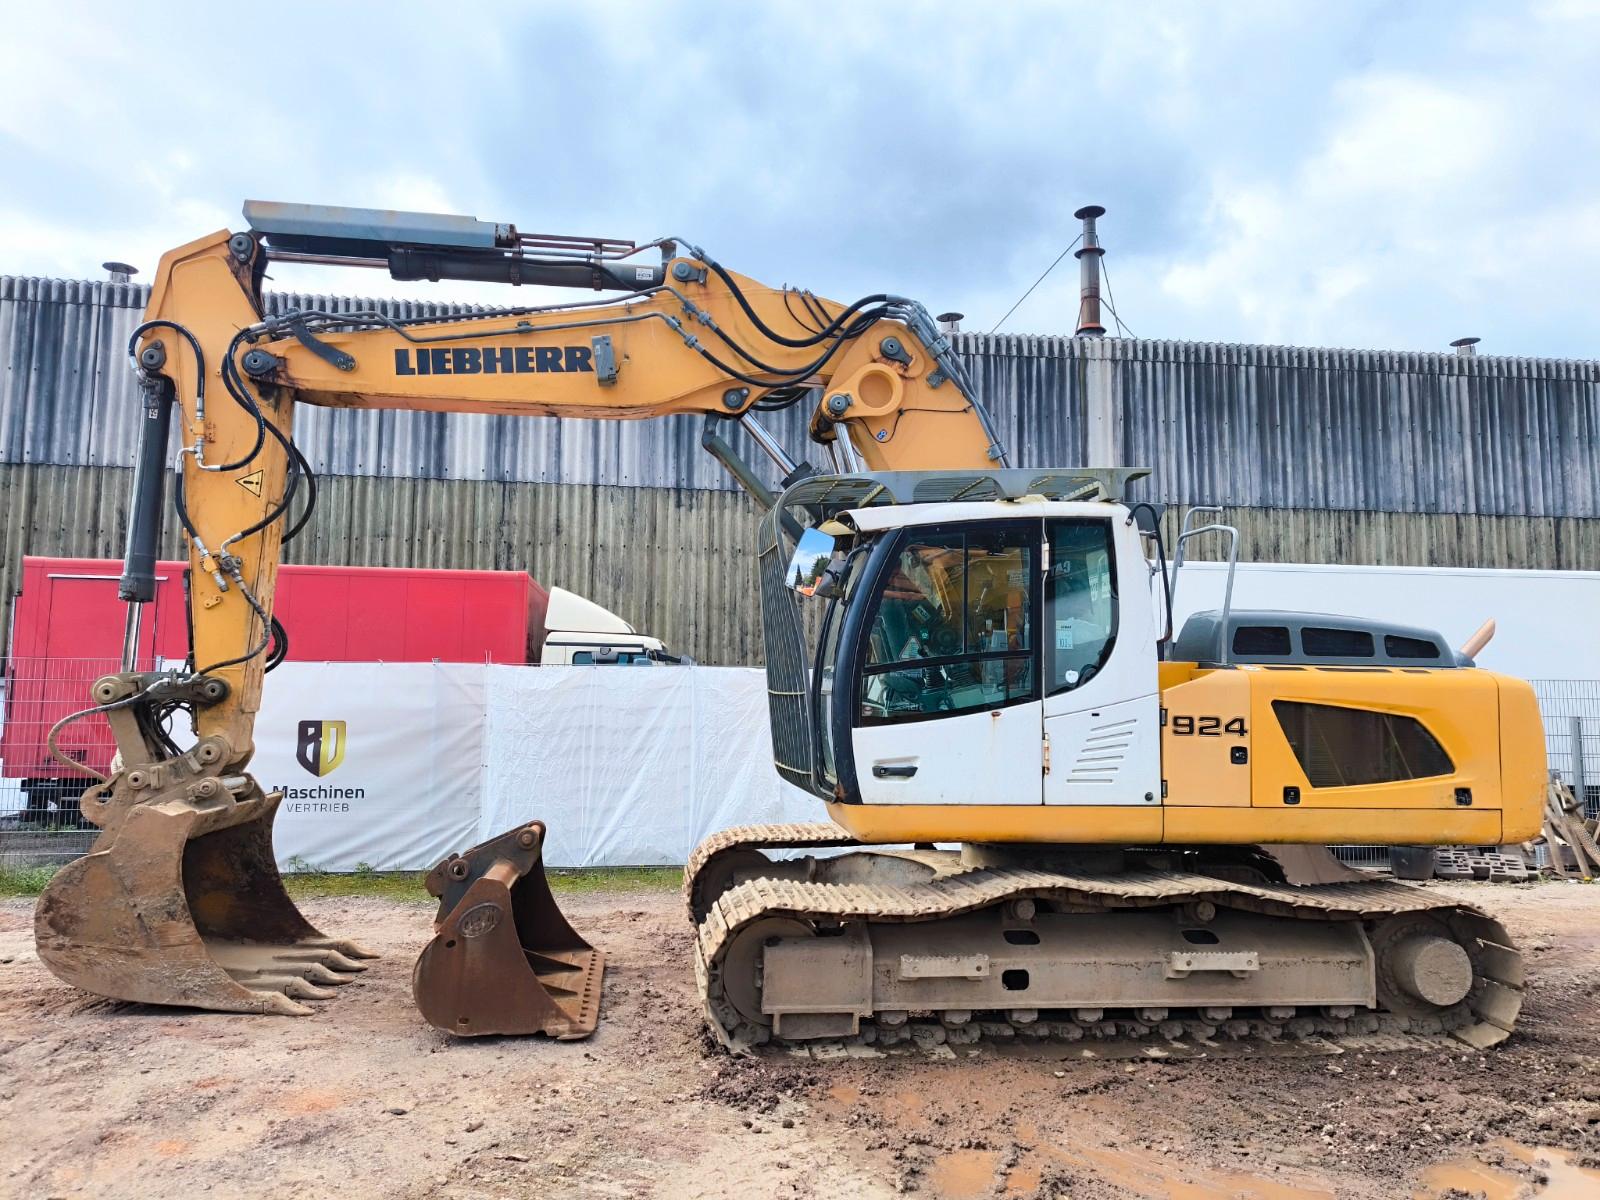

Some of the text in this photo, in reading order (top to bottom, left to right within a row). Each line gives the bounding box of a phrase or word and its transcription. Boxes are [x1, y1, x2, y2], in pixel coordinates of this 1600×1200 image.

[395, 346, 594, 375] LIEBHERR
[1172, 715, 1248, 736] 924
[286, 803, 350, 812] VERTRIEB
